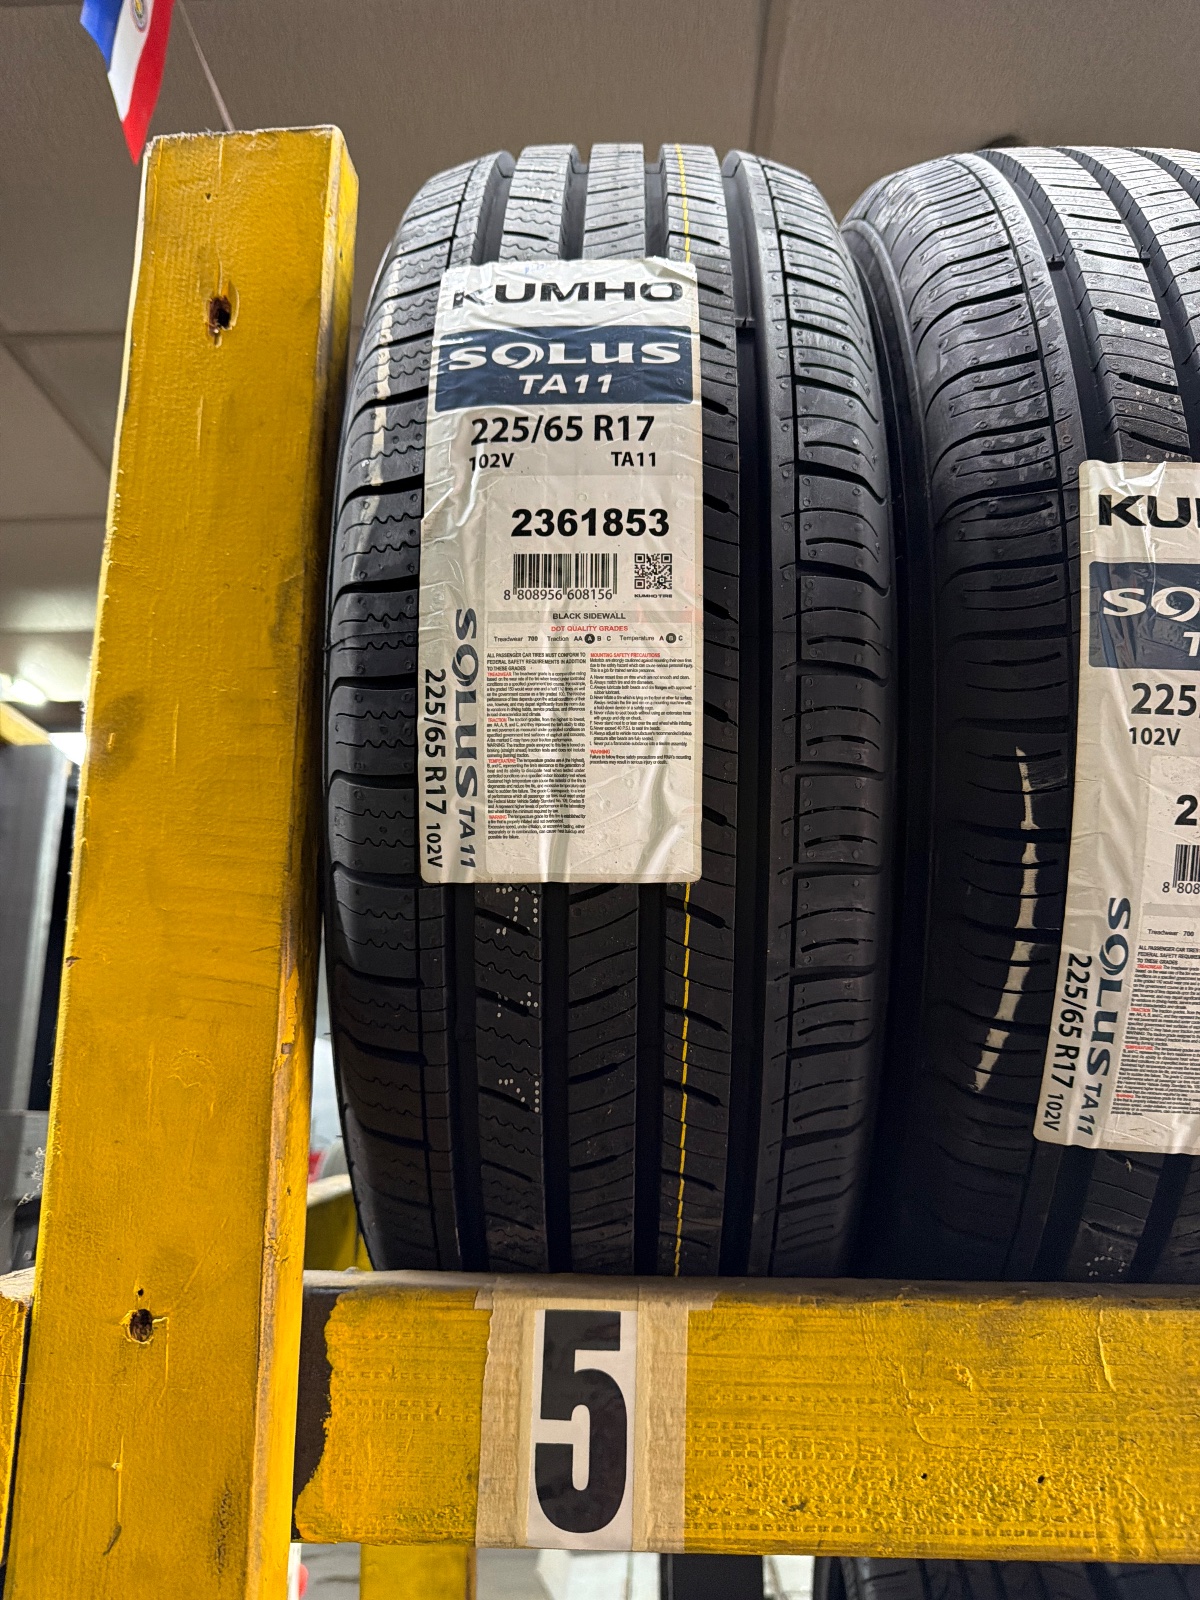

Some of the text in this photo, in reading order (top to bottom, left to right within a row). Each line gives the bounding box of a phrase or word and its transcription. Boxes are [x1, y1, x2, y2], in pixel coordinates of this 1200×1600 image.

[453, 281, 683, 309] KUMHO
[448, 342, 682, 371] SOLUS
[518, 374, 612, 396] TA11
[471, 415, 655, 446] 225/65 R17
[468, 452, 514, 472] 102V
[611, 452, 656, 467] TA11
[511, 508, 670, 538] 2361853
[1098, 494, 1200, 528] KU
[504, 588, 612, 600] 8 808956 608156
[452, 608, 478, 868] SOLUS TA11
[1129, 726, 1181, 746] 102V
[424, 668, 447, 868] 225/65 R17 102V
[1174, 794, 1198, 826] 2
[1162, 882, 1170, 893] 8
[1077, 898, 1131, 1136] SOLUS TA11
[1043, 953, 1092, 1132] 225/65 R17 102V
[535, 1309, 627, 1534] 5
